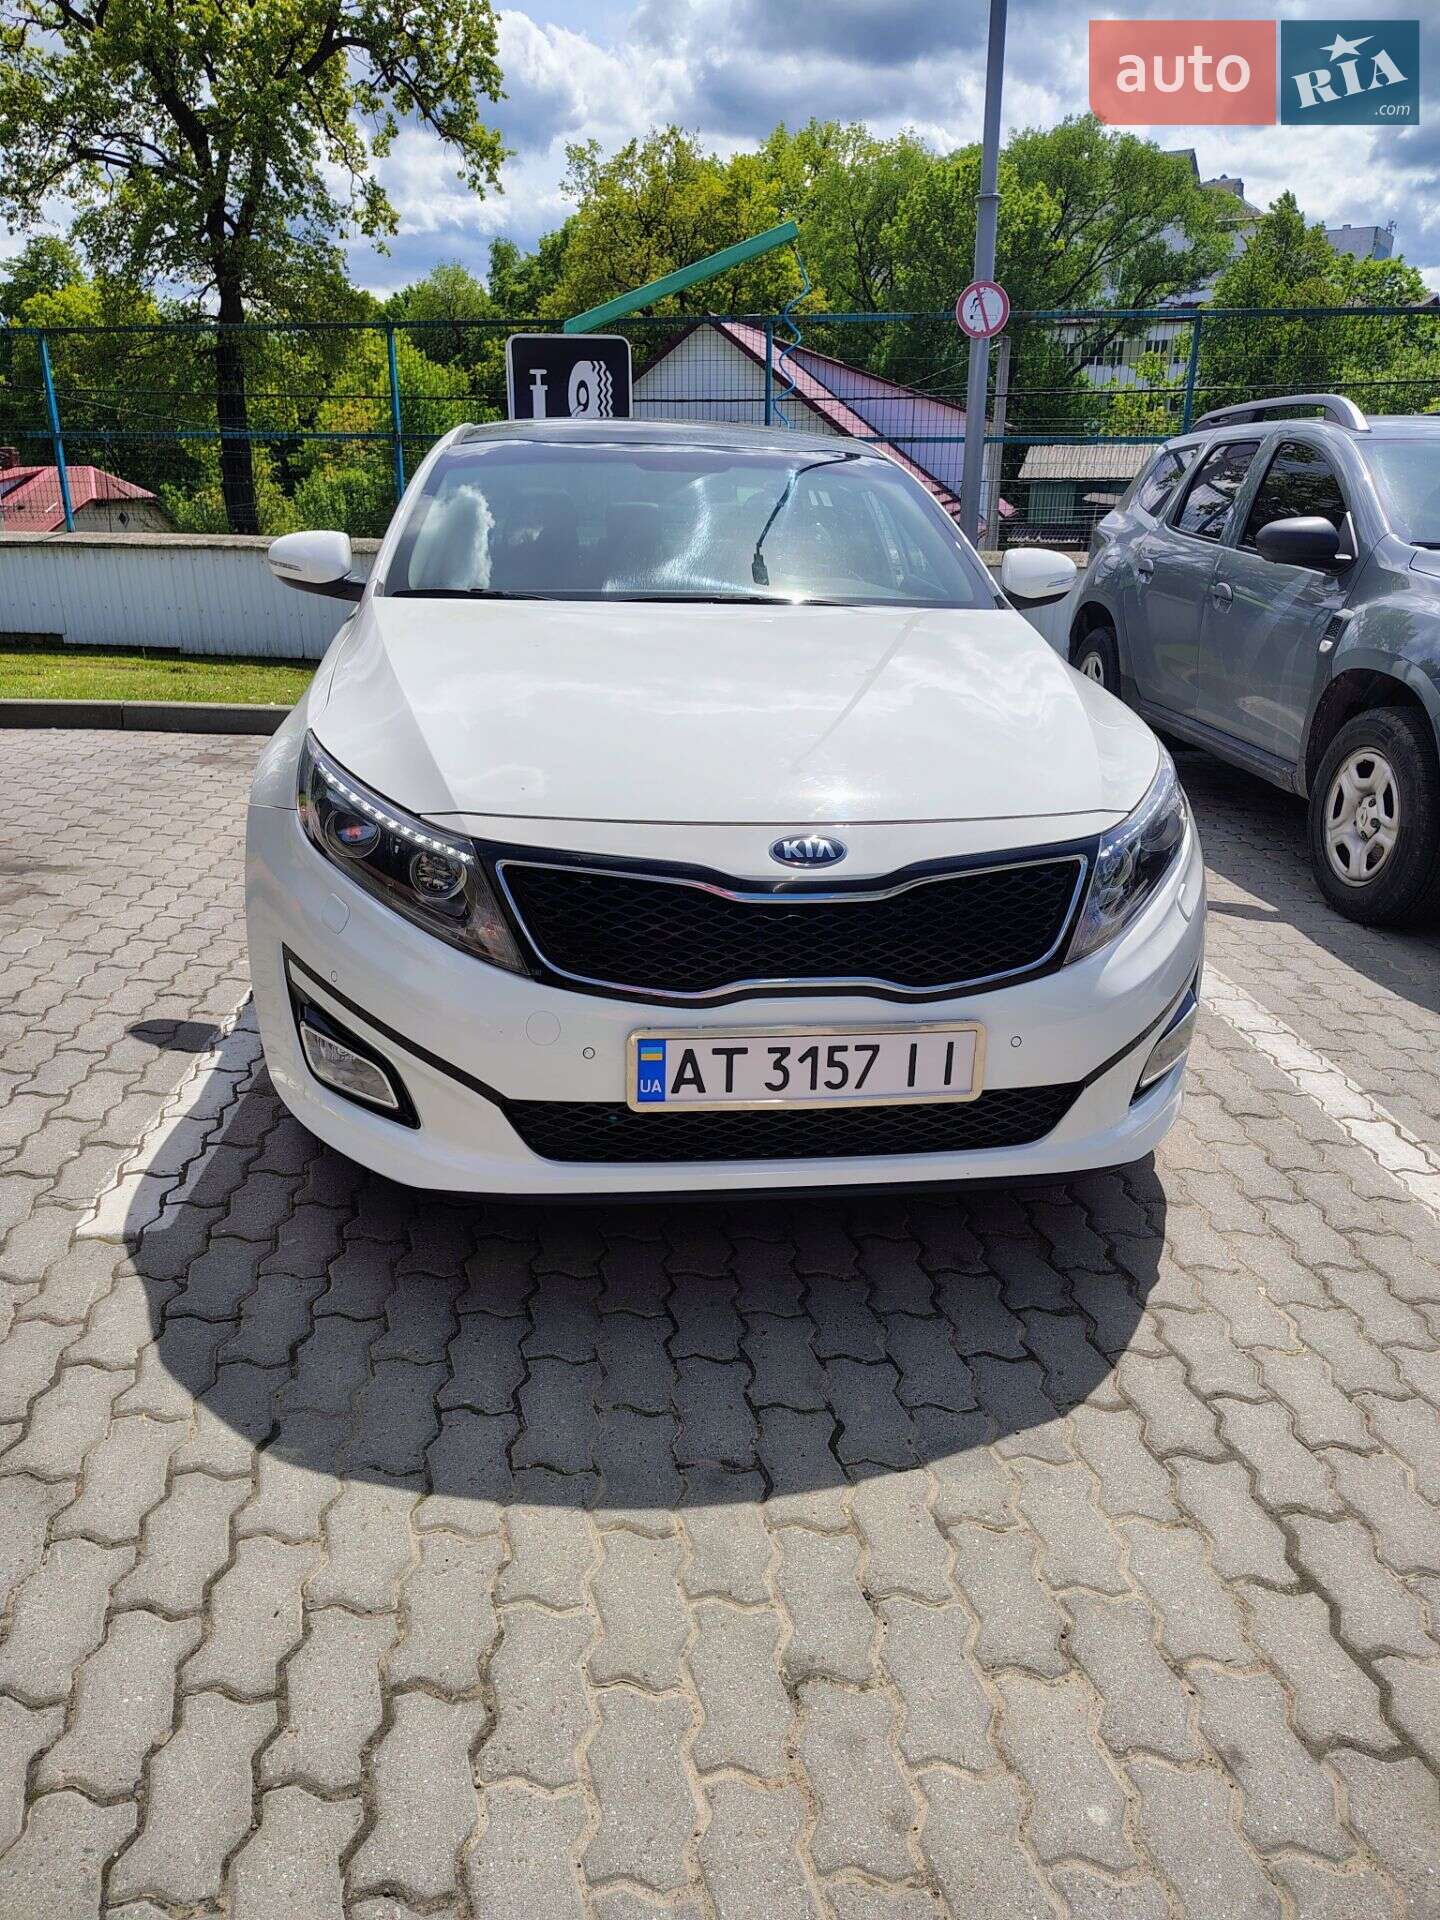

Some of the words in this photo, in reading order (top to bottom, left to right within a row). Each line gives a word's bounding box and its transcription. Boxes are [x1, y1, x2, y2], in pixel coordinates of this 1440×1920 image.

[782, 839, 837, 858] KIA
[671, 1047, 749, 1094] AT
[764, 1044, 881, 1092] 3157
[640, 1079, 662, 1094] UA
